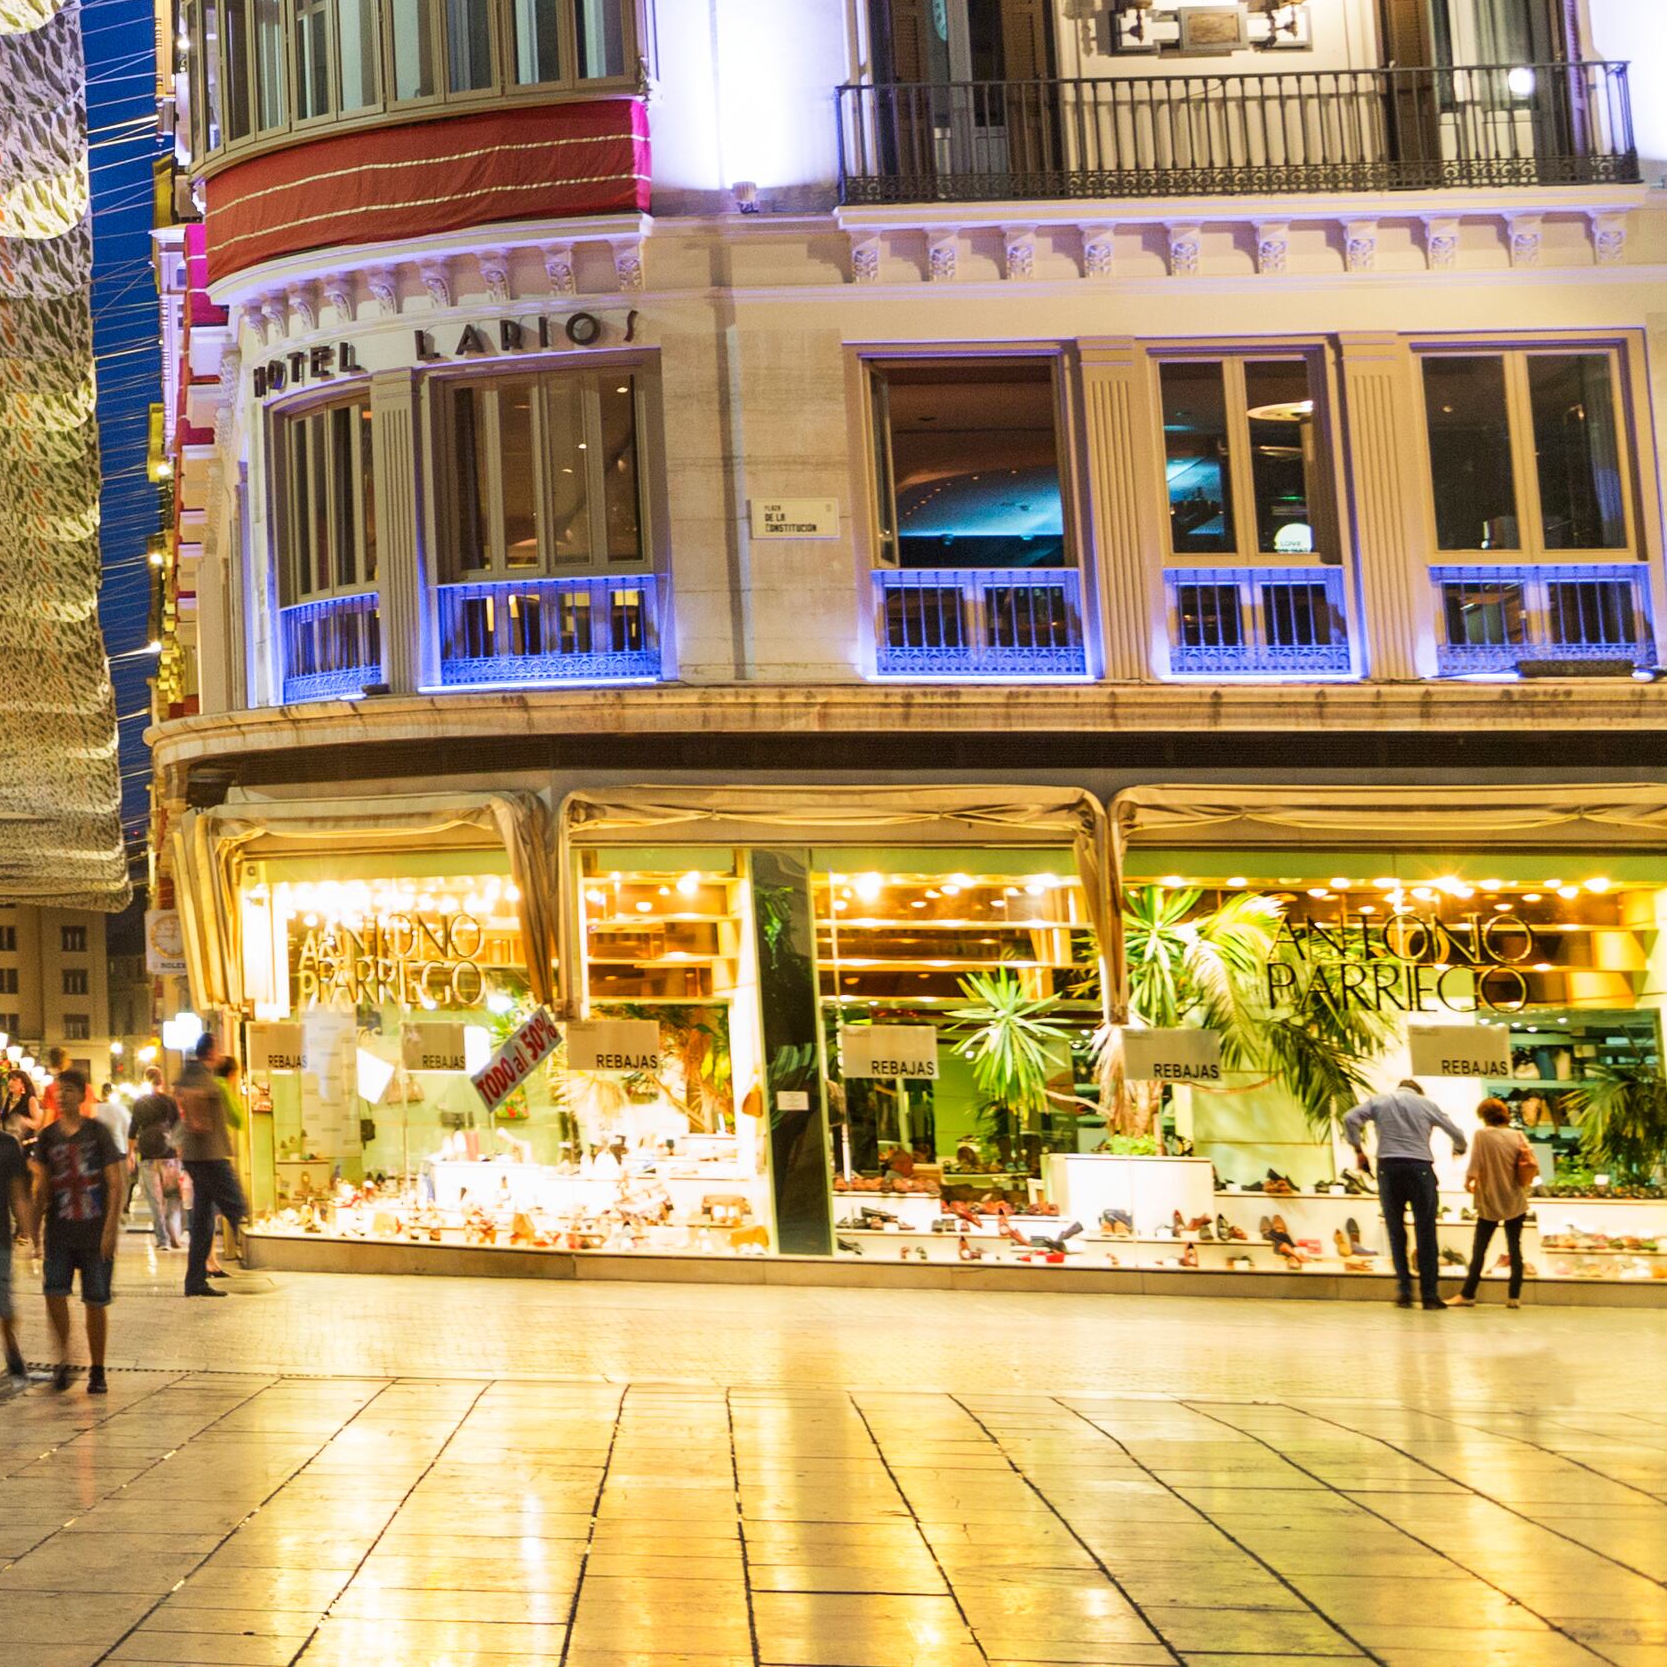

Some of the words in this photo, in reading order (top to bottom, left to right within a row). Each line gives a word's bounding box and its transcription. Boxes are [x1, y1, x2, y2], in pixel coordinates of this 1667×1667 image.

[253, 341, 364, 398] HOTEL
[413, 309, 639, 362] LARIOS
[764, 513, 774, 522] DE
[776, 514, 785, 522] LA
[1266, 961, 1529, 1014] PARRIEGO
[519, 1012, 558, 1062] 50%
[268, 1054, 308, 1070] REBAJAS
[422, 1054, 465, 1070] REBAJAS
[512, 1045, 530, 1075] al
[595, 1053, 659, 1070] REBAJAS
[870, 1060, 936, 1077] REBAJAS
[1441, 1059, 1509, 1077] REBAJAS
[1153, 1062, 1221, 1080] REBAJAS
[475, 1055, 517, 1106] TODO
